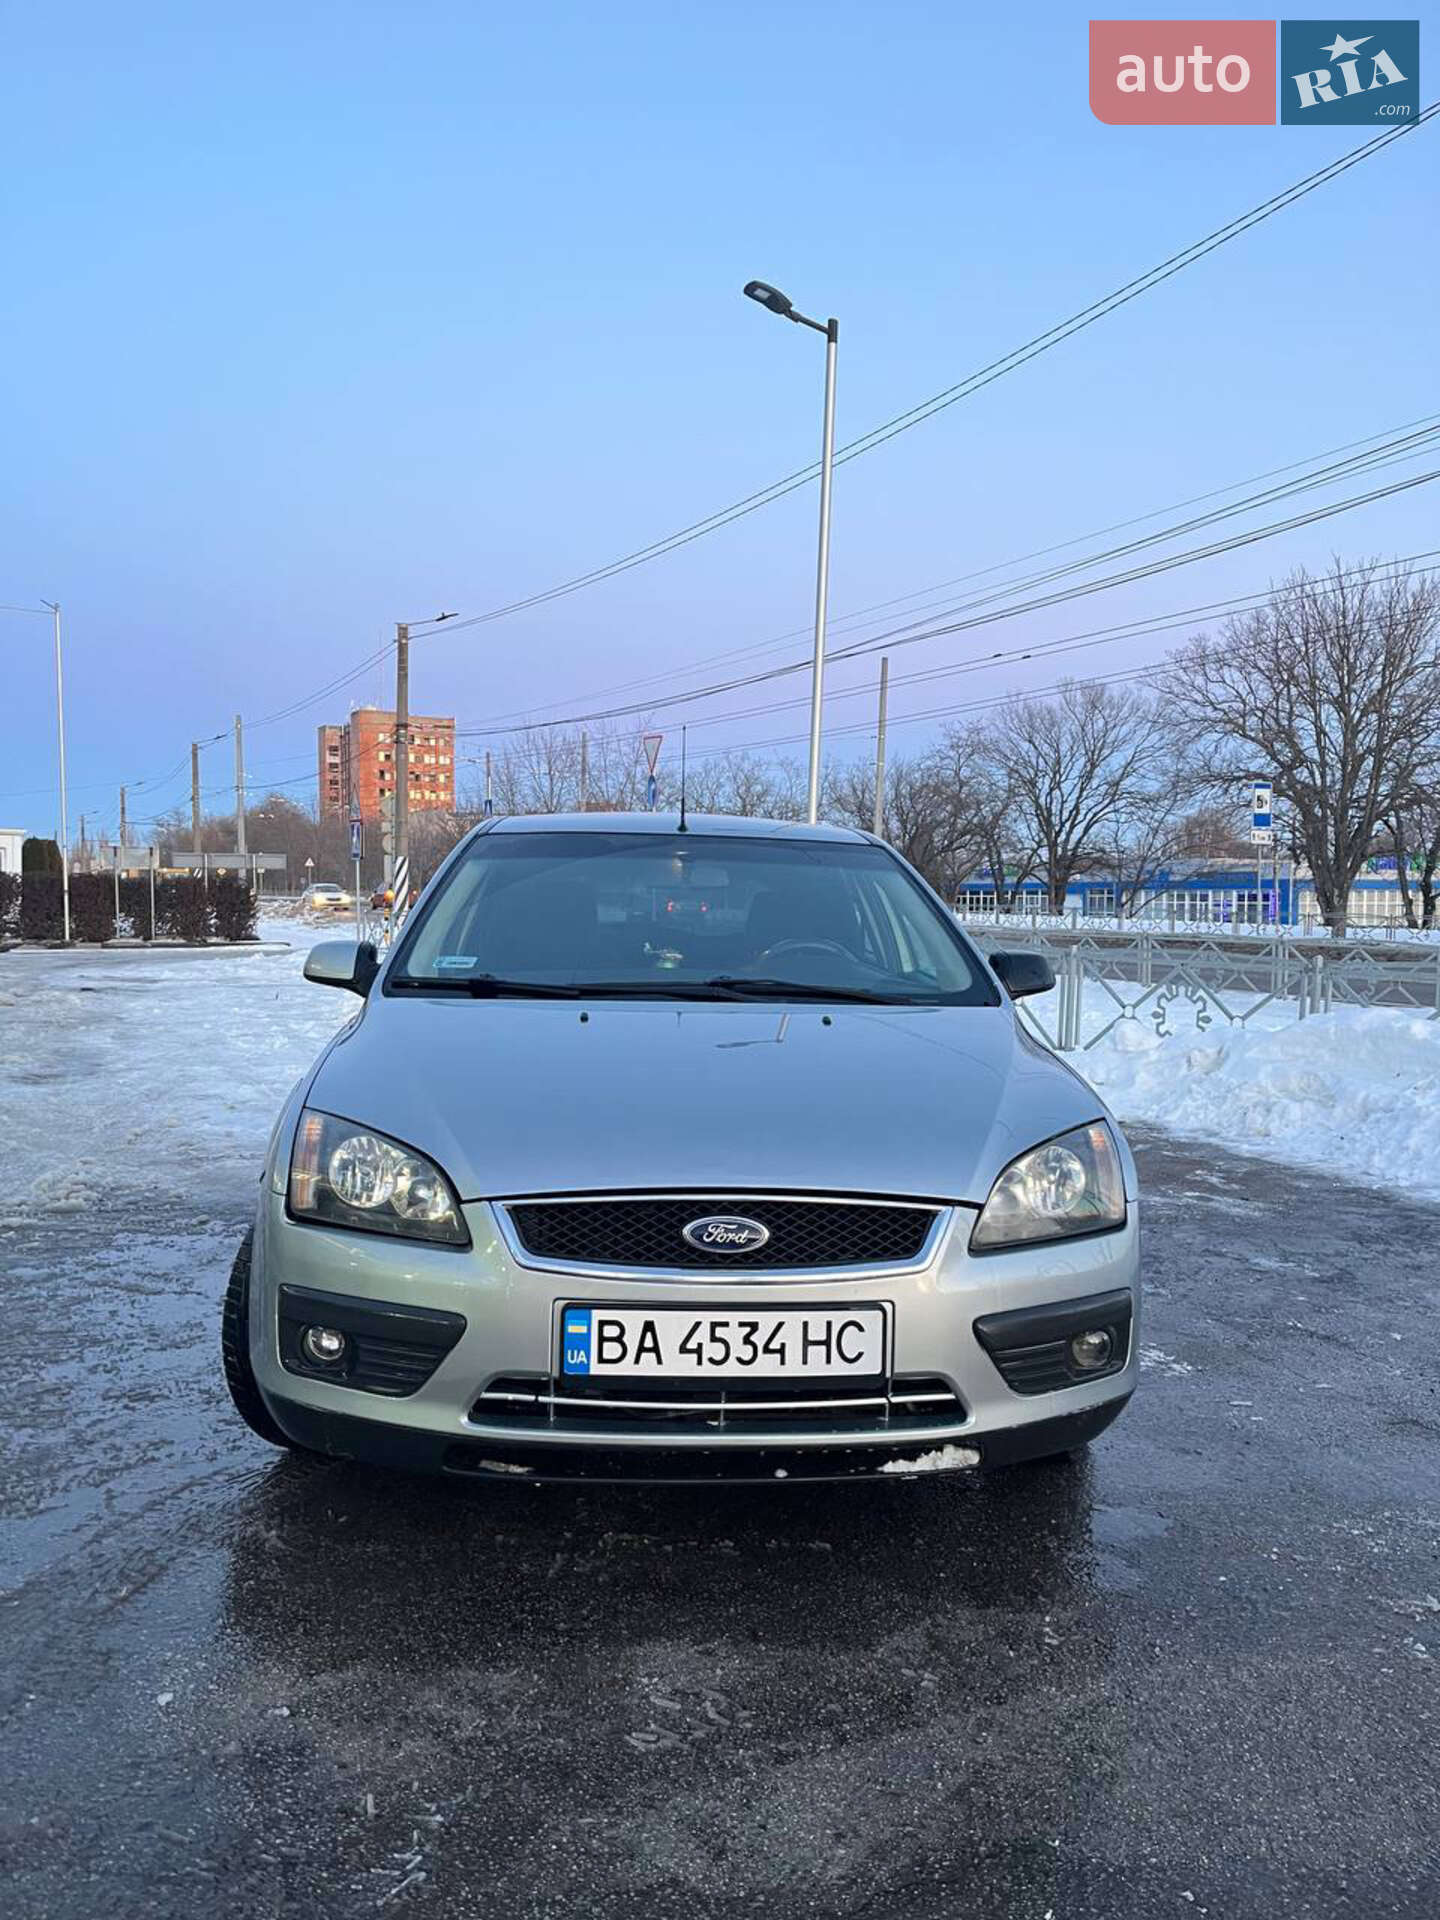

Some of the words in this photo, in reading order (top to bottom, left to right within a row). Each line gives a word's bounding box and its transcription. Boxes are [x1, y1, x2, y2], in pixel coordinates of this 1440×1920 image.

[702, 1223, 750, 1244] Ford
[597, 1319, 663, 1365] BA
[678, 1320, 787, 1366] 4534
[801, 1320, 866, 1365] HC
[566, 1349, 588, 1364] UA
